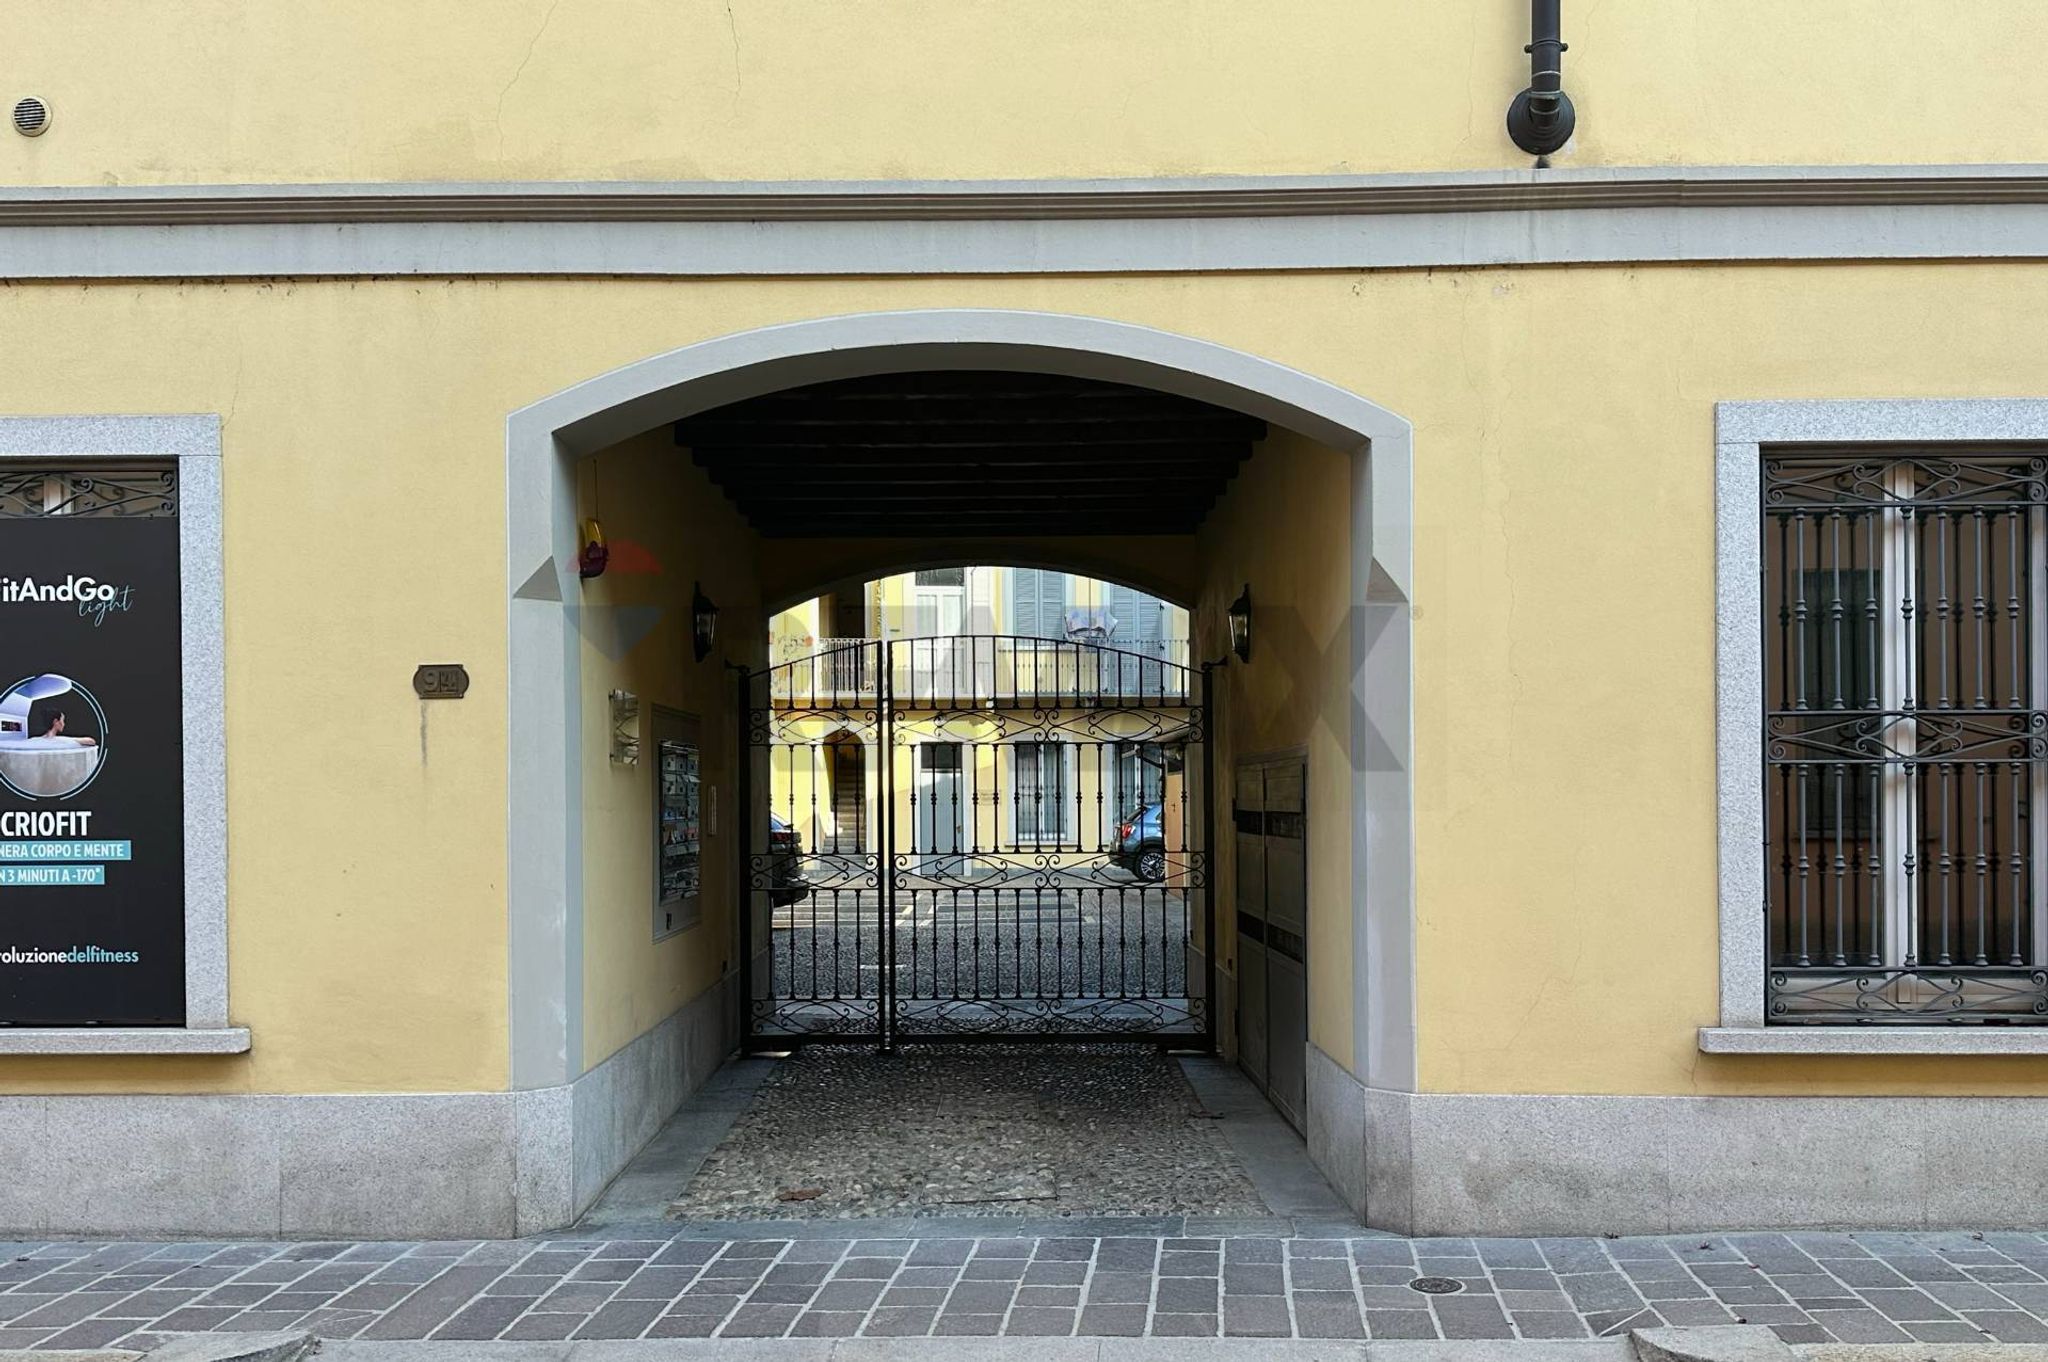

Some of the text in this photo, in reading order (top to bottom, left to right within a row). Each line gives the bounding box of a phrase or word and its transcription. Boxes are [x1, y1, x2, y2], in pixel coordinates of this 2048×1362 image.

[0, 575, 114, 601] itAndGo
[79, 585, 135, 627] light
[1, 811, 92, 836] CRIOFIT
[31, 844, 71, 857] CORPO
[74, 844, 81, 857] E
[84, 843, 124, 857] MENTE
[8, 869, 15, 882] 3
[18, 869, 59, 882] MINUTI
[61, 869, 70, 882] A
[72, 867, 101, 882] -170°
